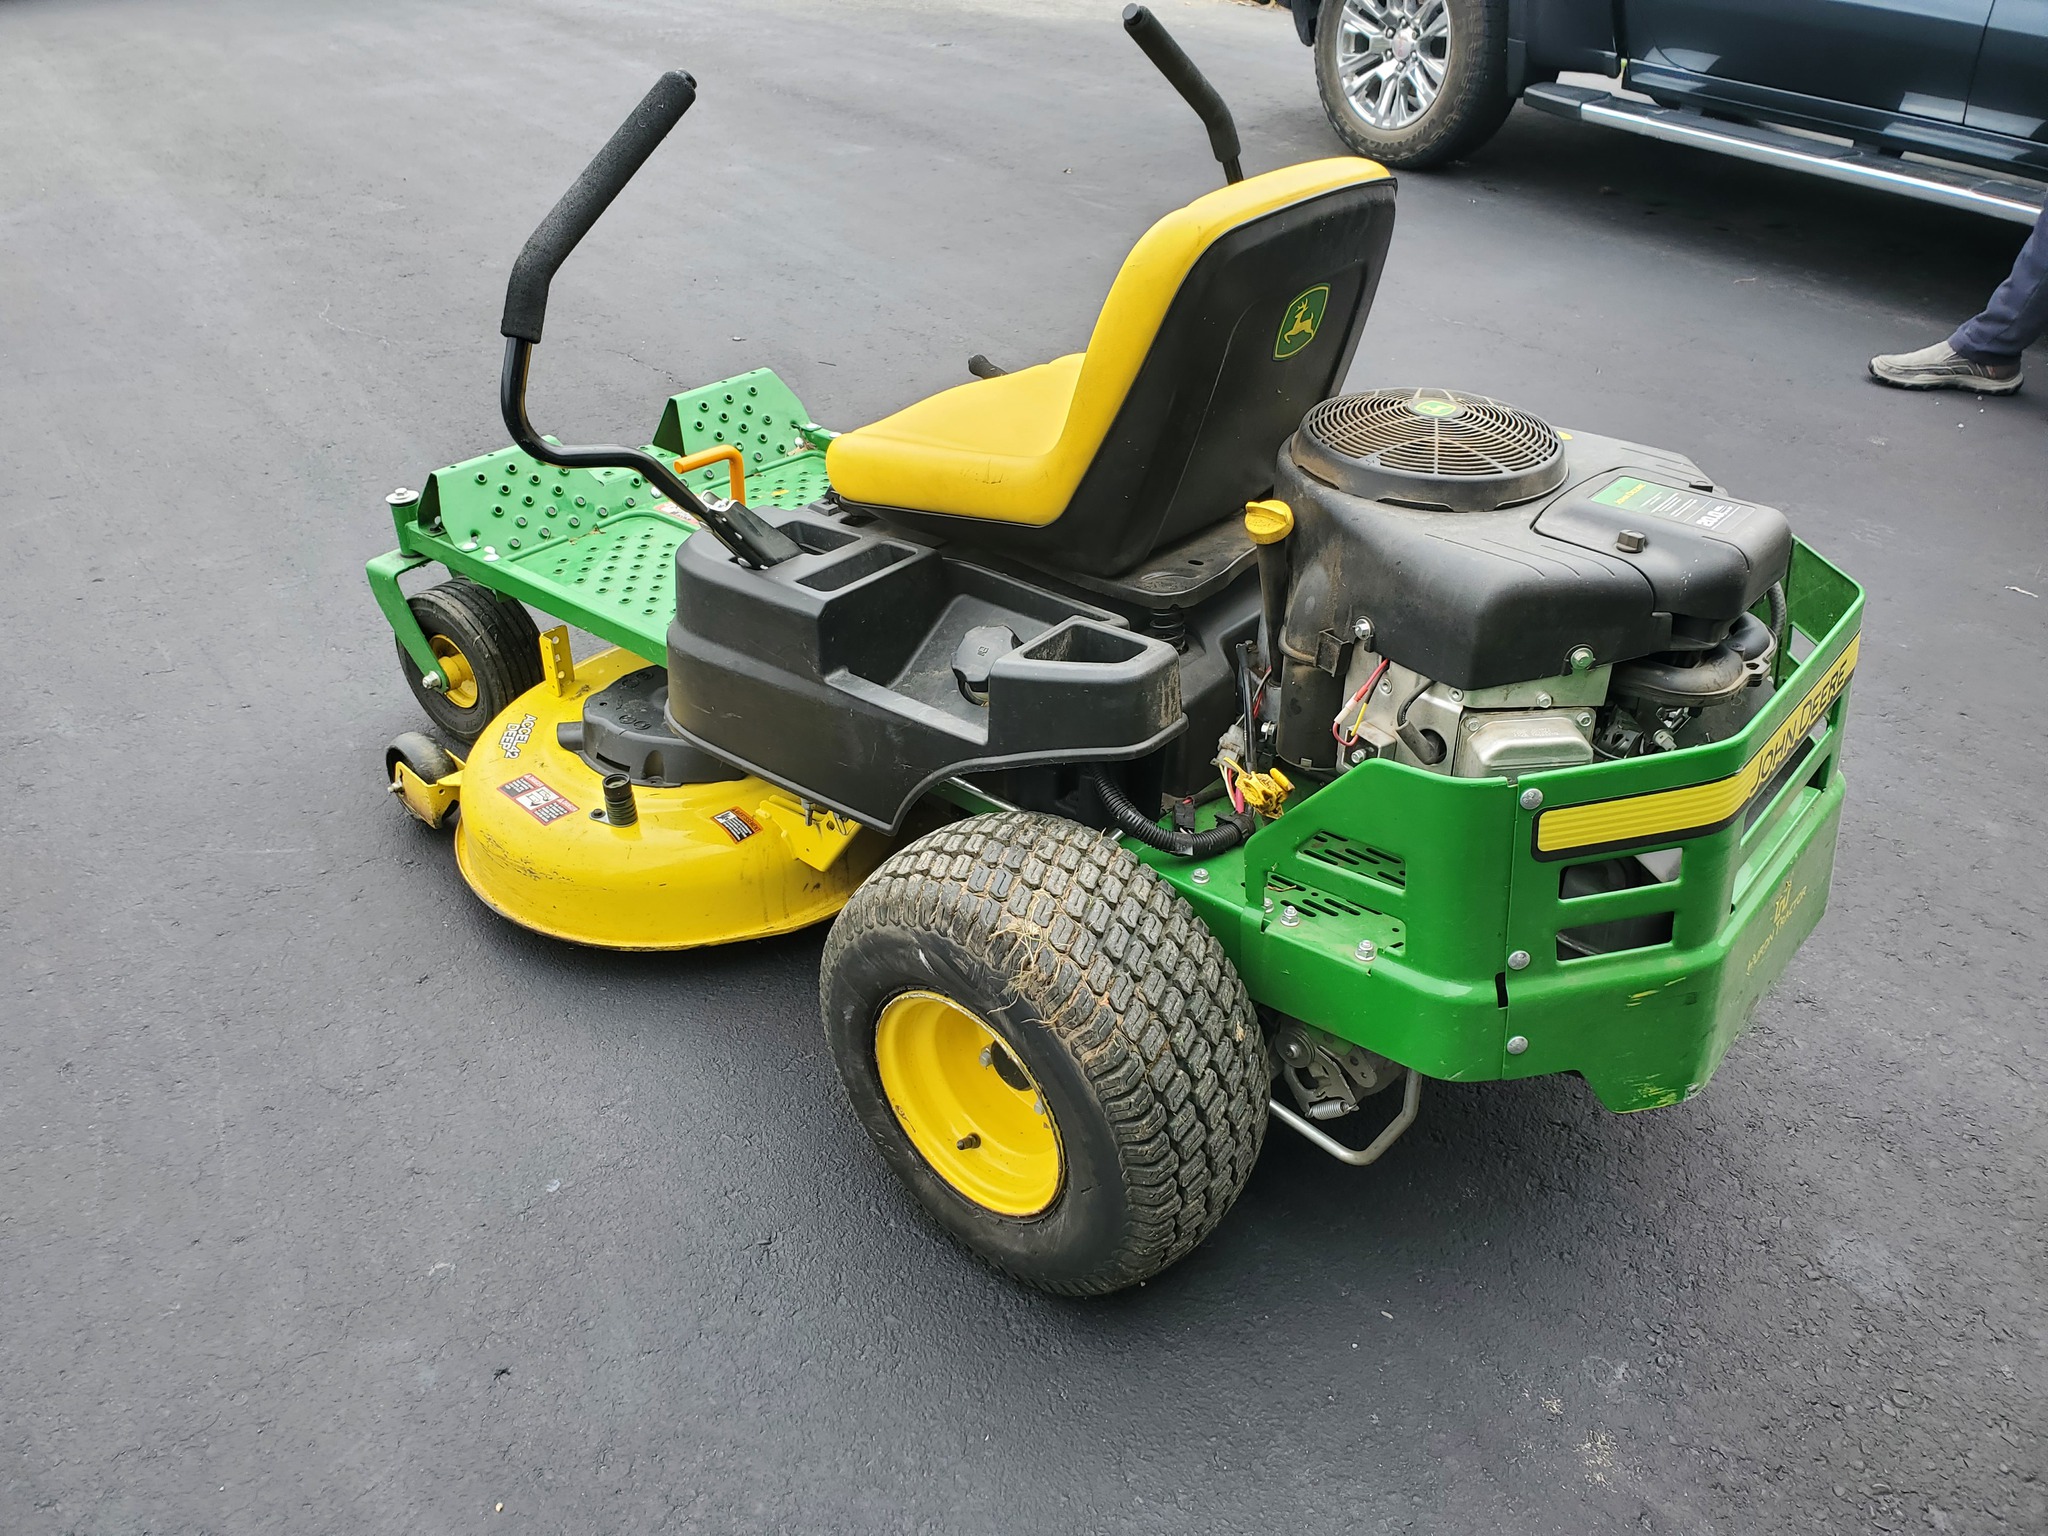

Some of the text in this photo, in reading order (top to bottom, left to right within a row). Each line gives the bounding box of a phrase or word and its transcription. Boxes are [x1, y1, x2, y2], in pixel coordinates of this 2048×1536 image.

[499, 723, 520, 750] DEEP
[513, 713, 538, 747] ACCEL
[1750, 659, 1848, 793] JOHN DEERE
[504, 745, 521, 759] 42
